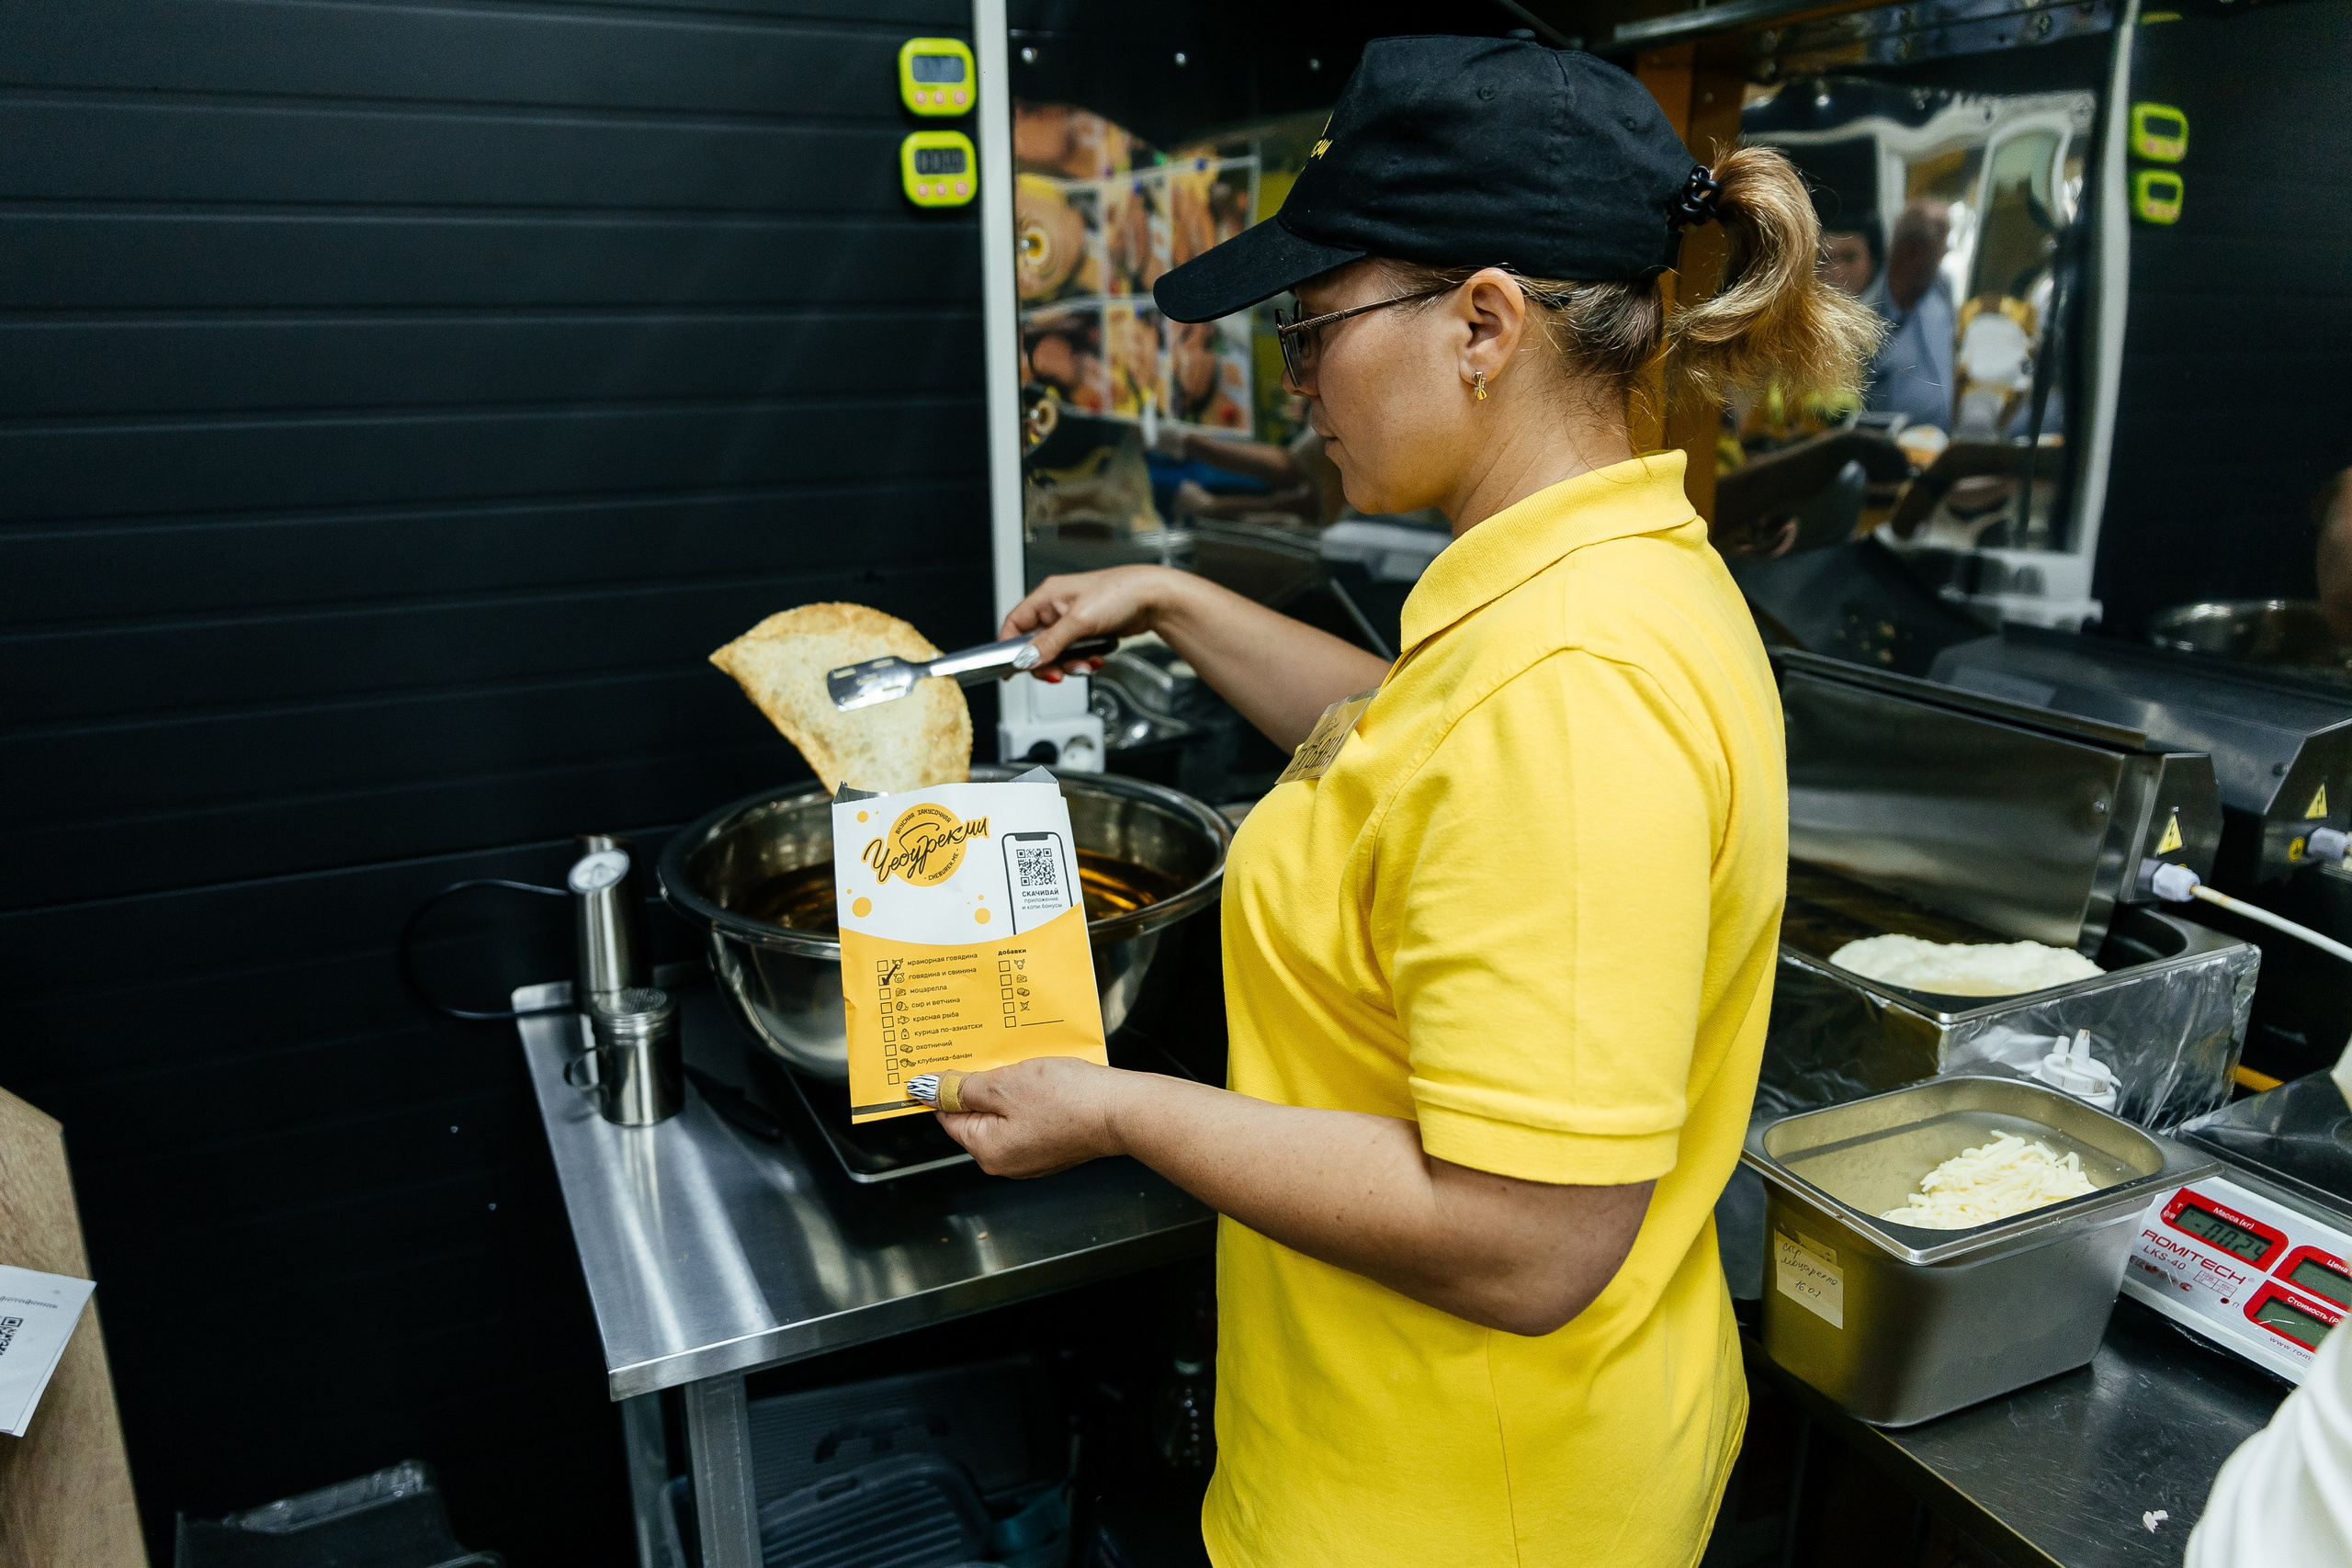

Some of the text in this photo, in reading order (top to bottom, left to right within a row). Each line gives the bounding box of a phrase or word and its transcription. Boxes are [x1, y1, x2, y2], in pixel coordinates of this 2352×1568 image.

[1285, 732, 1345, 775] ТАТЬЯНА
[895, 808, 952, 835] ВКУСНАЯ ЗАКУСОЧНАЯ
[863, 817, 989, 883] Чебурекми
[928, 852, 959, 881] CHEBUREK.ME
[1022, 887, 1059, 897] СКАЧИВАЙ
[907, 953, 978, 966] мраморная говядина
[997, 948, 1027, 956] добавки
[908, 971, 941, 980] говядина
[947, 967, 978, 976] свинина
[910, 985, 948, 995] моцарелла
[910, 1000, 925, 1009] сыр
[932, 997, 961, 1006] ветчина
[912, 1011, 959, 1023] красная рыба
[914, 1022, 984, 1037] курица по-азиатски
[915, 1040, 953, 1051] охотничий
[917, 1053, 973, 1065] клубника-банан
[2212, 1206, 2256, 1231] Масса (кг)
[2141, 1229, 2247, 1285] ROMITECH
[2143, 1245, 2187, 1270] LKS-40
[2326, 1258, 2349, 1274] Цена
[2287, 1295, 2328, 1321] Стоимость
[2269, 1337, 2313, 1362] www.rom
